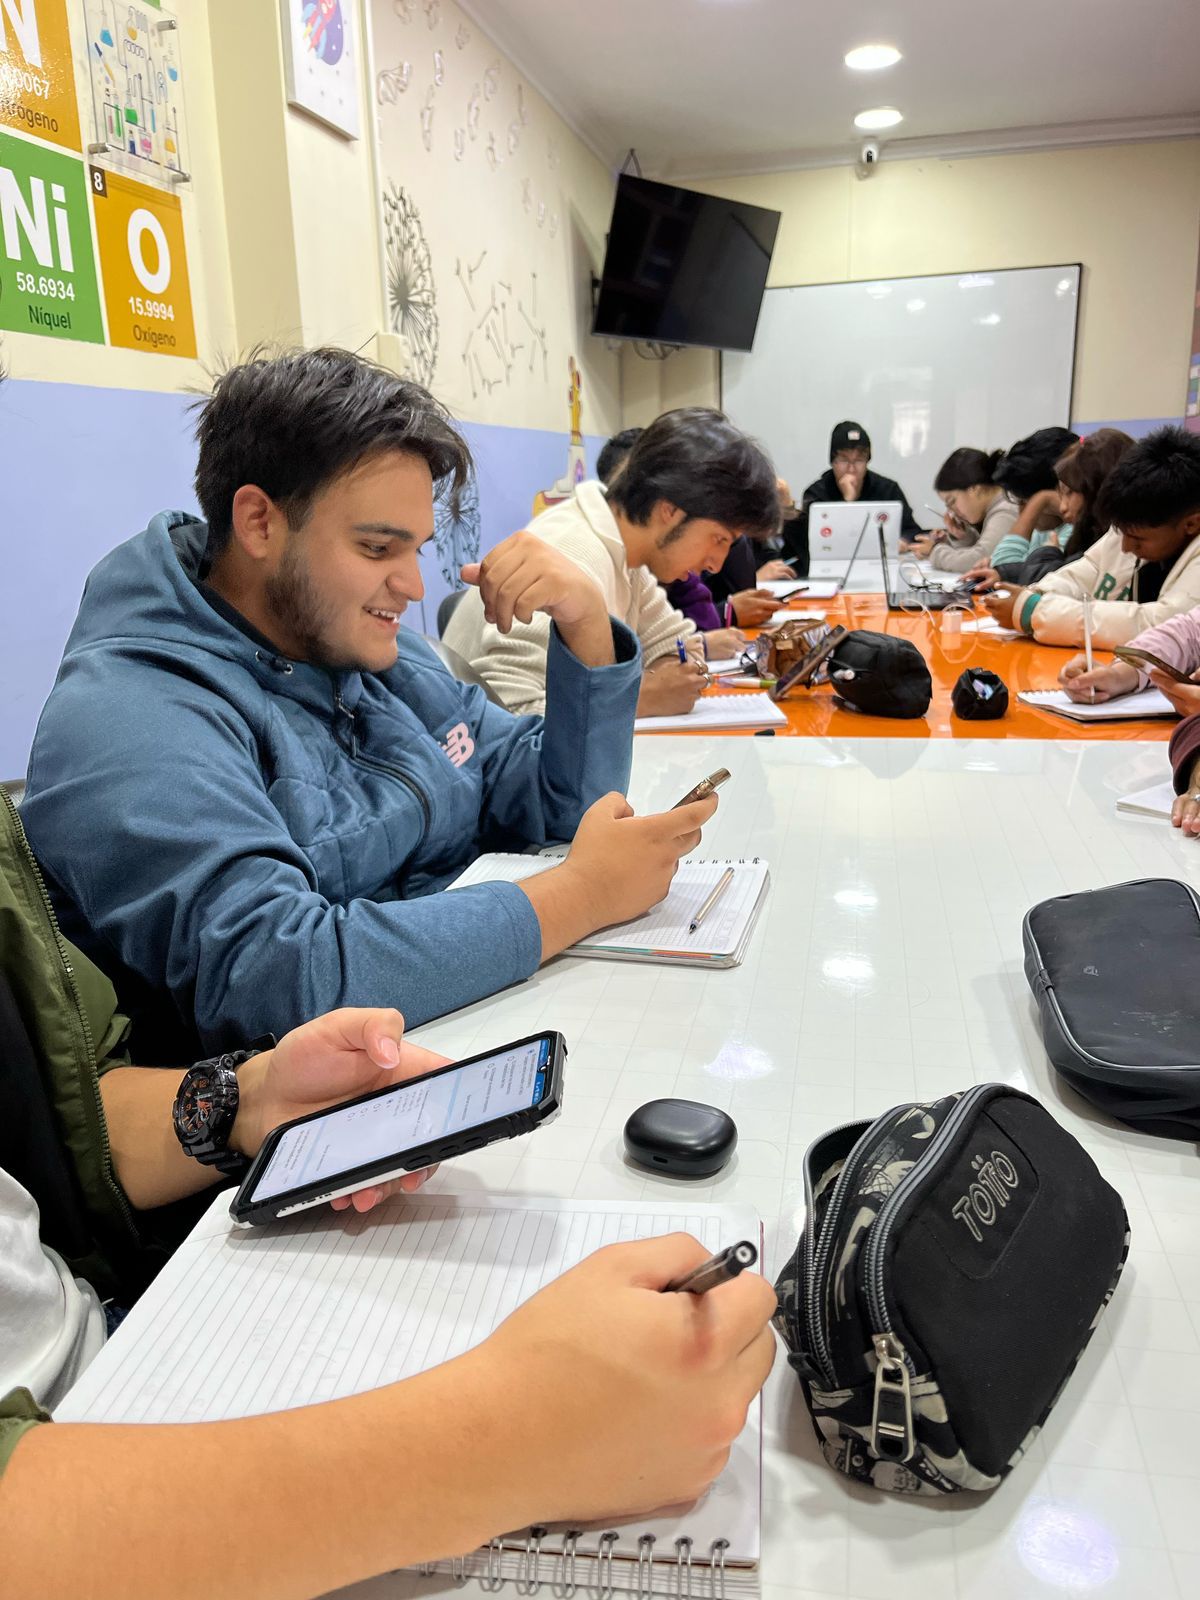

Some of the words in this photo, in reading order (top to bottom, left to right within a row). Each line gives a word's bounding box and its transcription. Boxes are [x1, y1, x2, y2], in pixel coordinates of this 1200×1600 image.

[93, 171, 103, 191] 8
[0, 166, 75, 273] Ni
[127, 208, 171, 295] O
[16, 271, 75, 301] 58.6934
[128, 296, 175, 322] 15.9994
